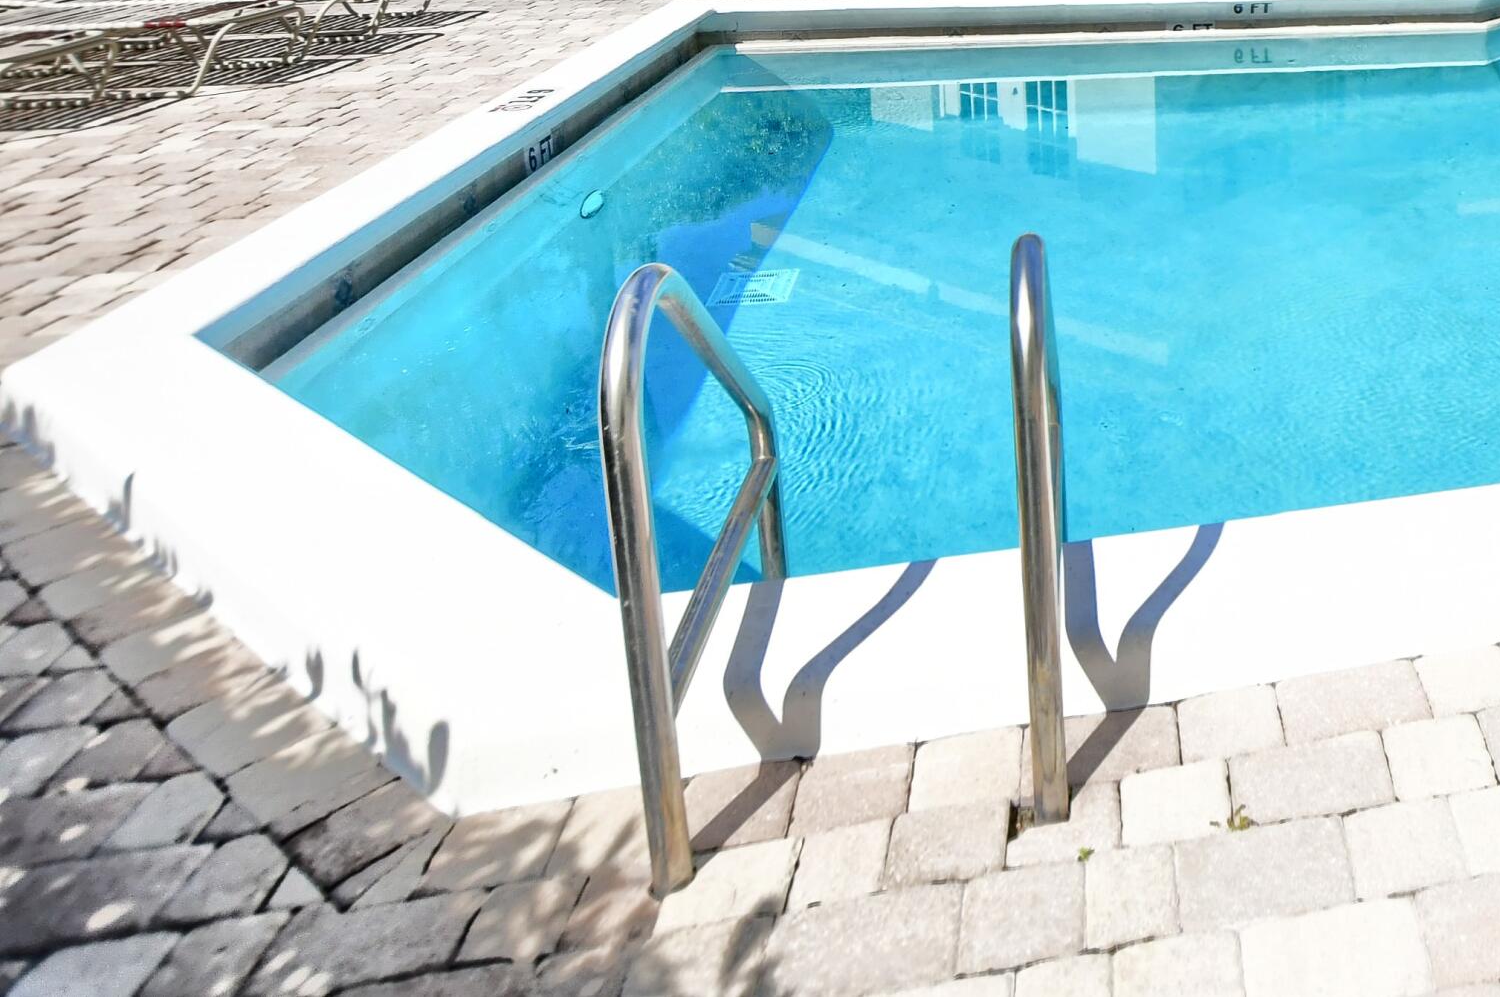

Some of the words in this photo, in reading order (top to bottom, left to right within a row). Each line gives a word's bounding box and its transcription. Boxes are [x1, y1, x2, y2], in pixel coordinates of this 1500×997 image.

[1233, 3, 1244, 14] 6
[1250, 2, 1272, 14] FT
[528, 146, 537, 172] 6
[539, 134, 554, 165] FT
